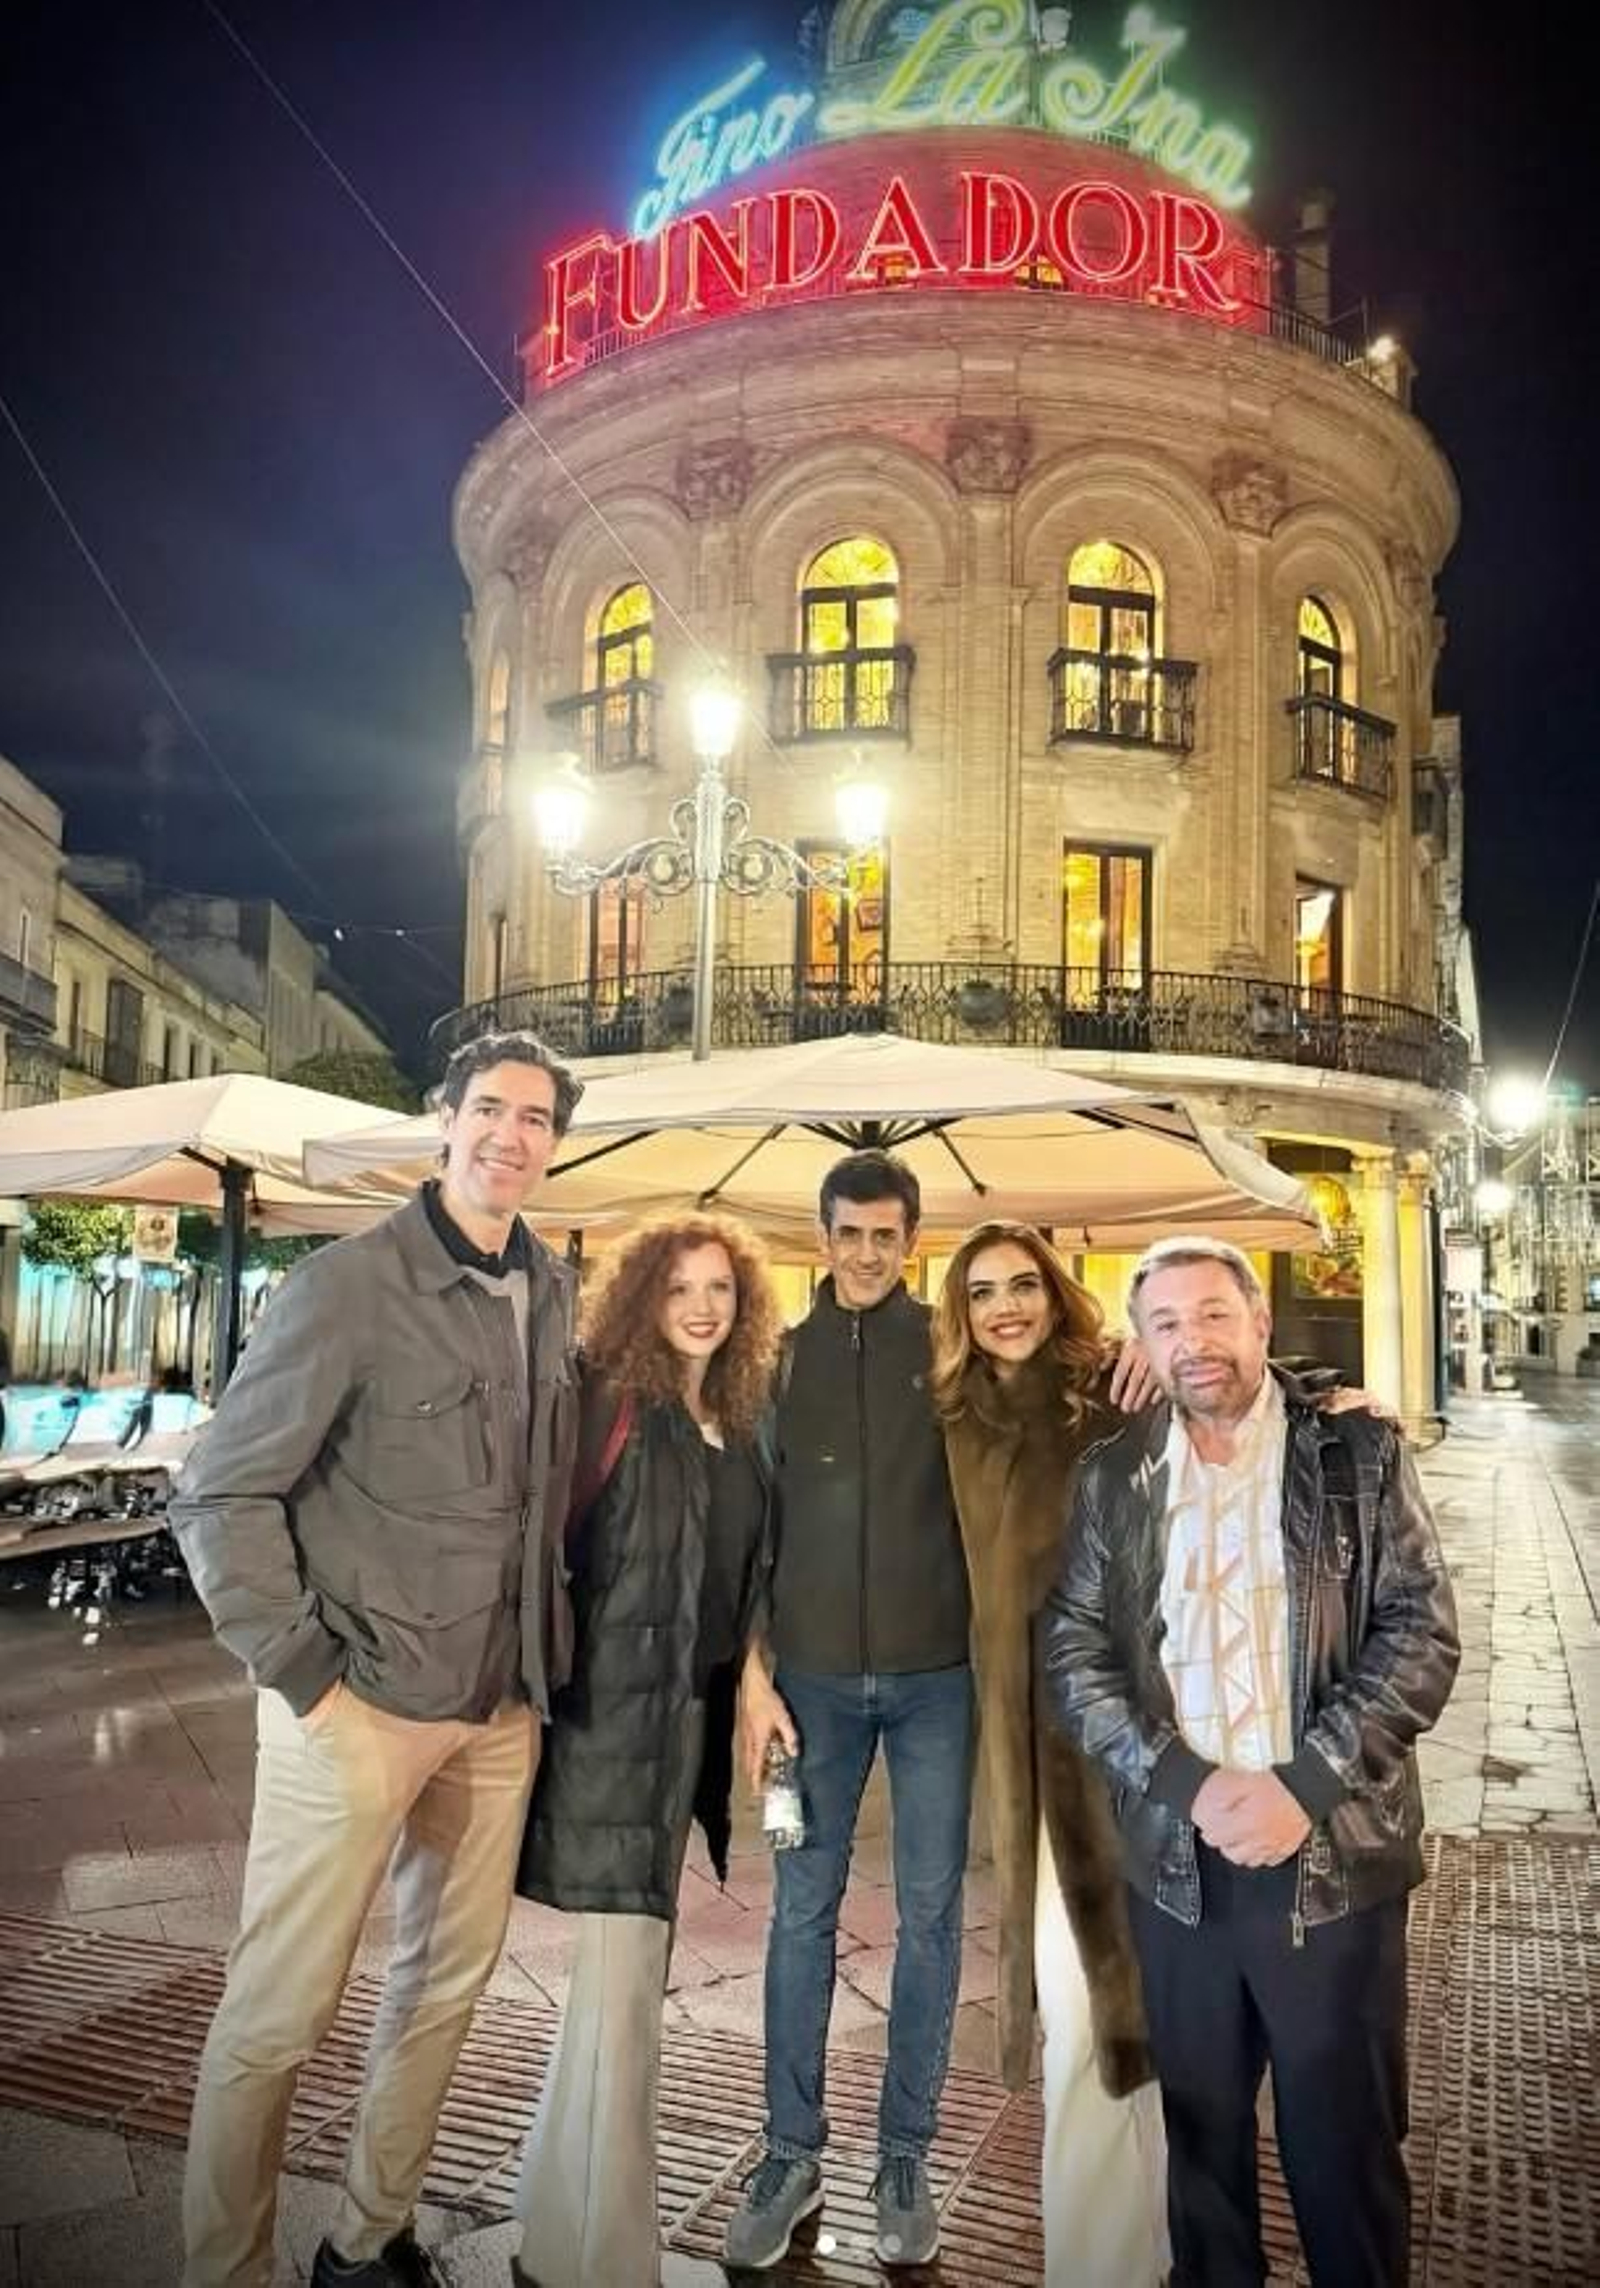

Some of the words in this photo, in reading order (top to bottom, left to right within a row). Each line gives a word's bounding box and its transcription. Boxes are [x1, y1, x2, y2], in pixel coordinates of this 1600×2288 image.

[634, 60, 815, 241] Fino
[817, 0, 1029, 130] La
[1044, 4, 1252, 207] Ina
[544, 171, 1239, 377] FUNDADOR
